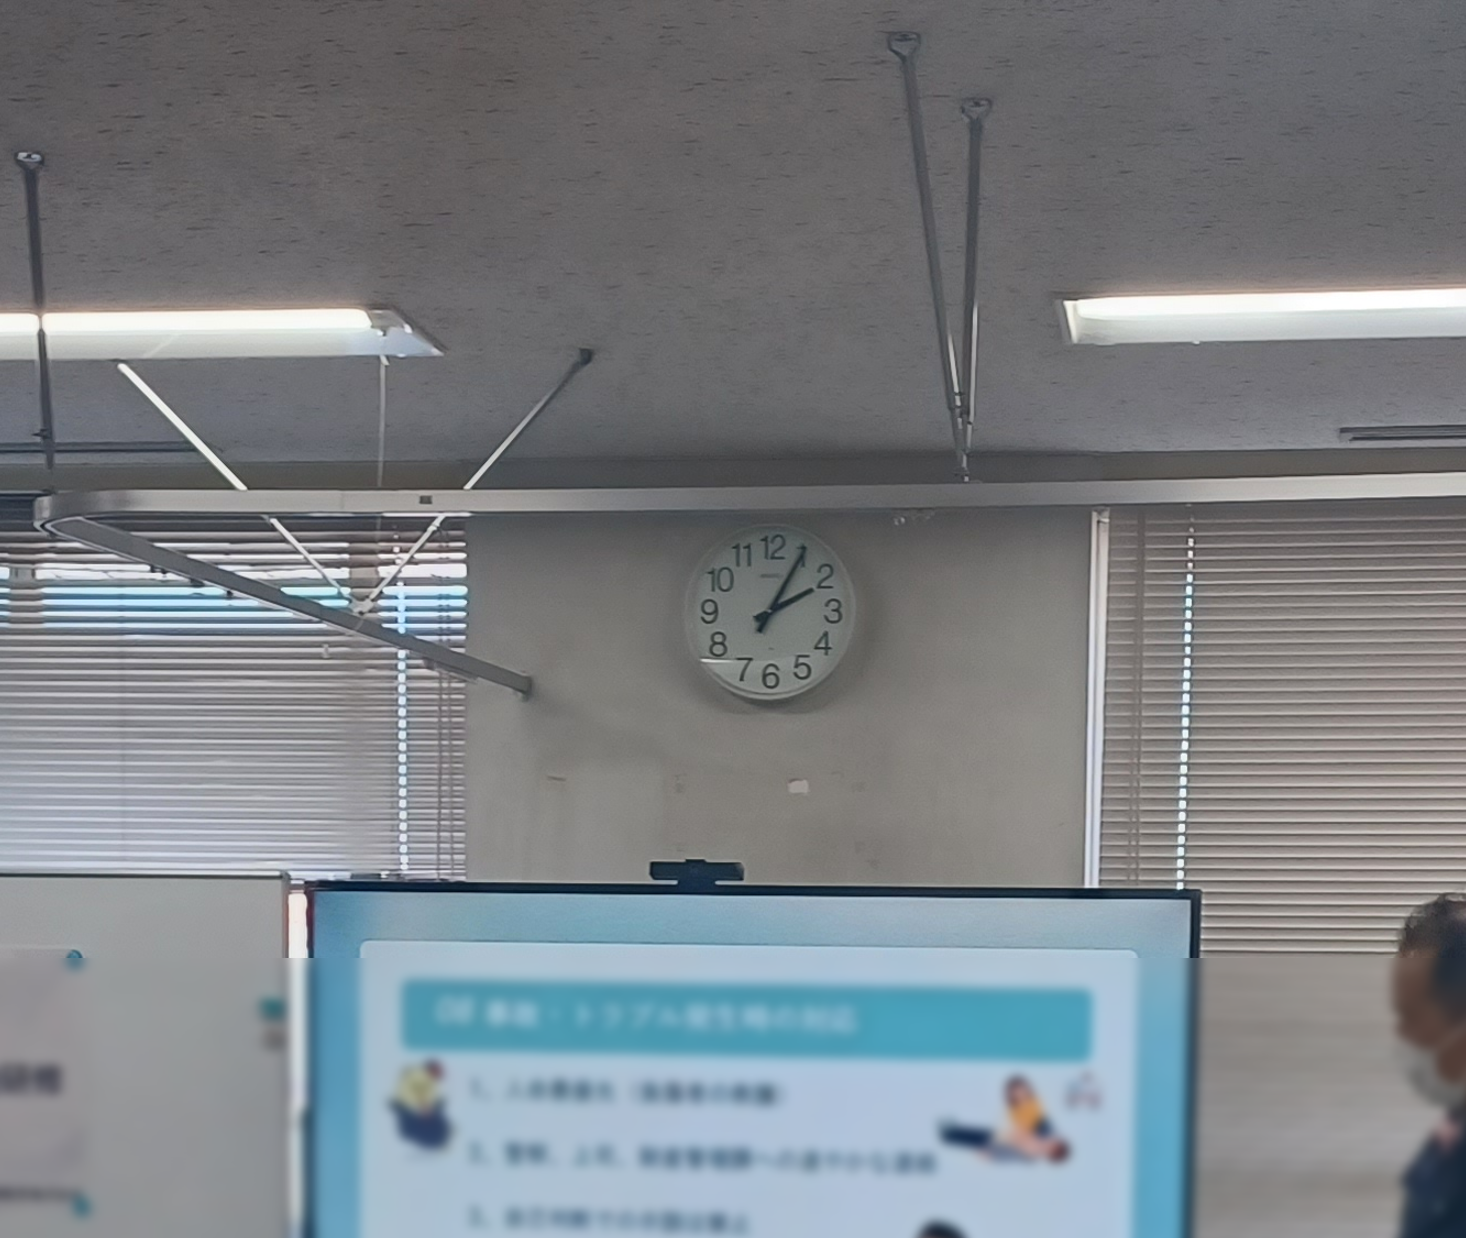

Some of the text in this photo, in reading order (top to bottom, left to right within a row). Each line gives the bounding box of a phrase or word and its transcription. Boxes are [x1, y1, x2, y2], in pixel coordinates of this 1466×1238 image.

[732, 543, 752, 567] 11
[760, 534, 786, 560] 12
[796, 544, 807, 568] 1
[706, 567, 734, 592] 10
[816, 564, 834, 589] 2
[700, 599, 719, 624] 9
[823, 598, 843, 624] 3
[709, 631, 728, 657] 8
[814, 631, 832, 656] 4
[735, 657, 754, 682] 7
[762, 663, 780, 689] 6
[793, 655, 812, 680] 5
